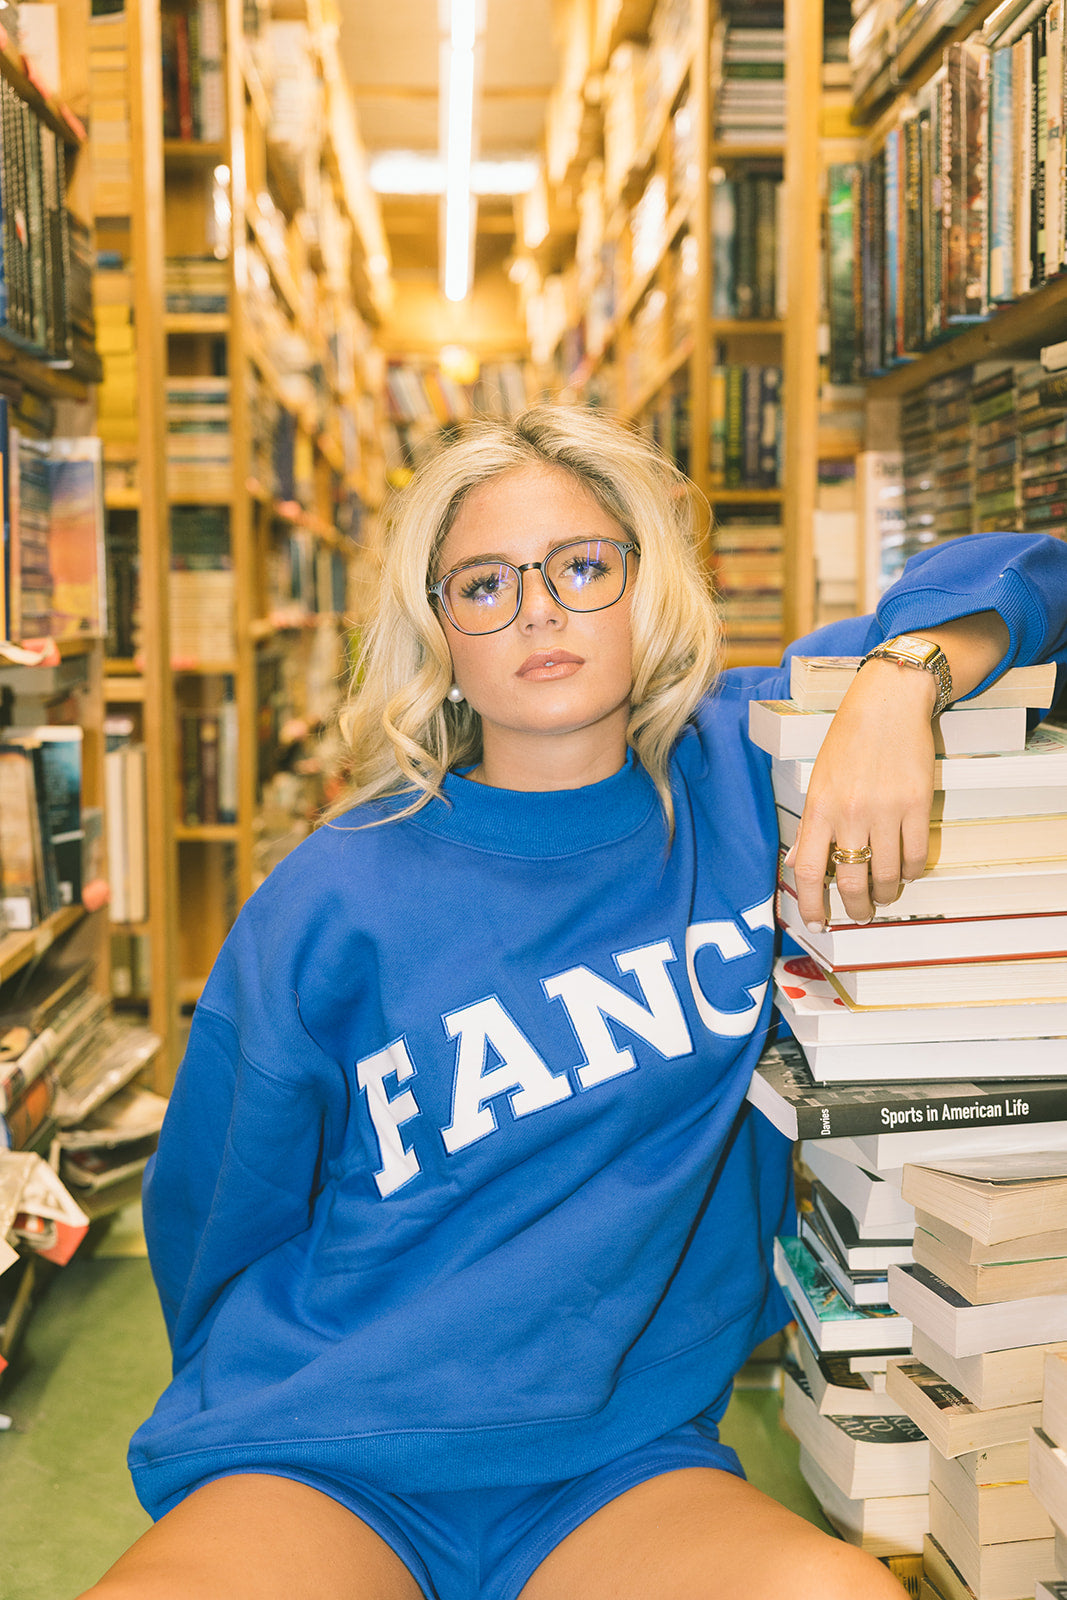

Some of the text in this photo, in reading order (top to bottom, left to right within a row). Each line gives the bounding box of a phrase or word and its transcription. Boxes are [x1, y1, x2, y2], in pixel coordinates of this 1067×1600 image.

[356, 896, 775, 1200] FANC
[820, 1108, 831, 1135] Davies
[881, 1098, 1030, 1128] Sports in American Life
[863, 1416, 894, 1432] TO
